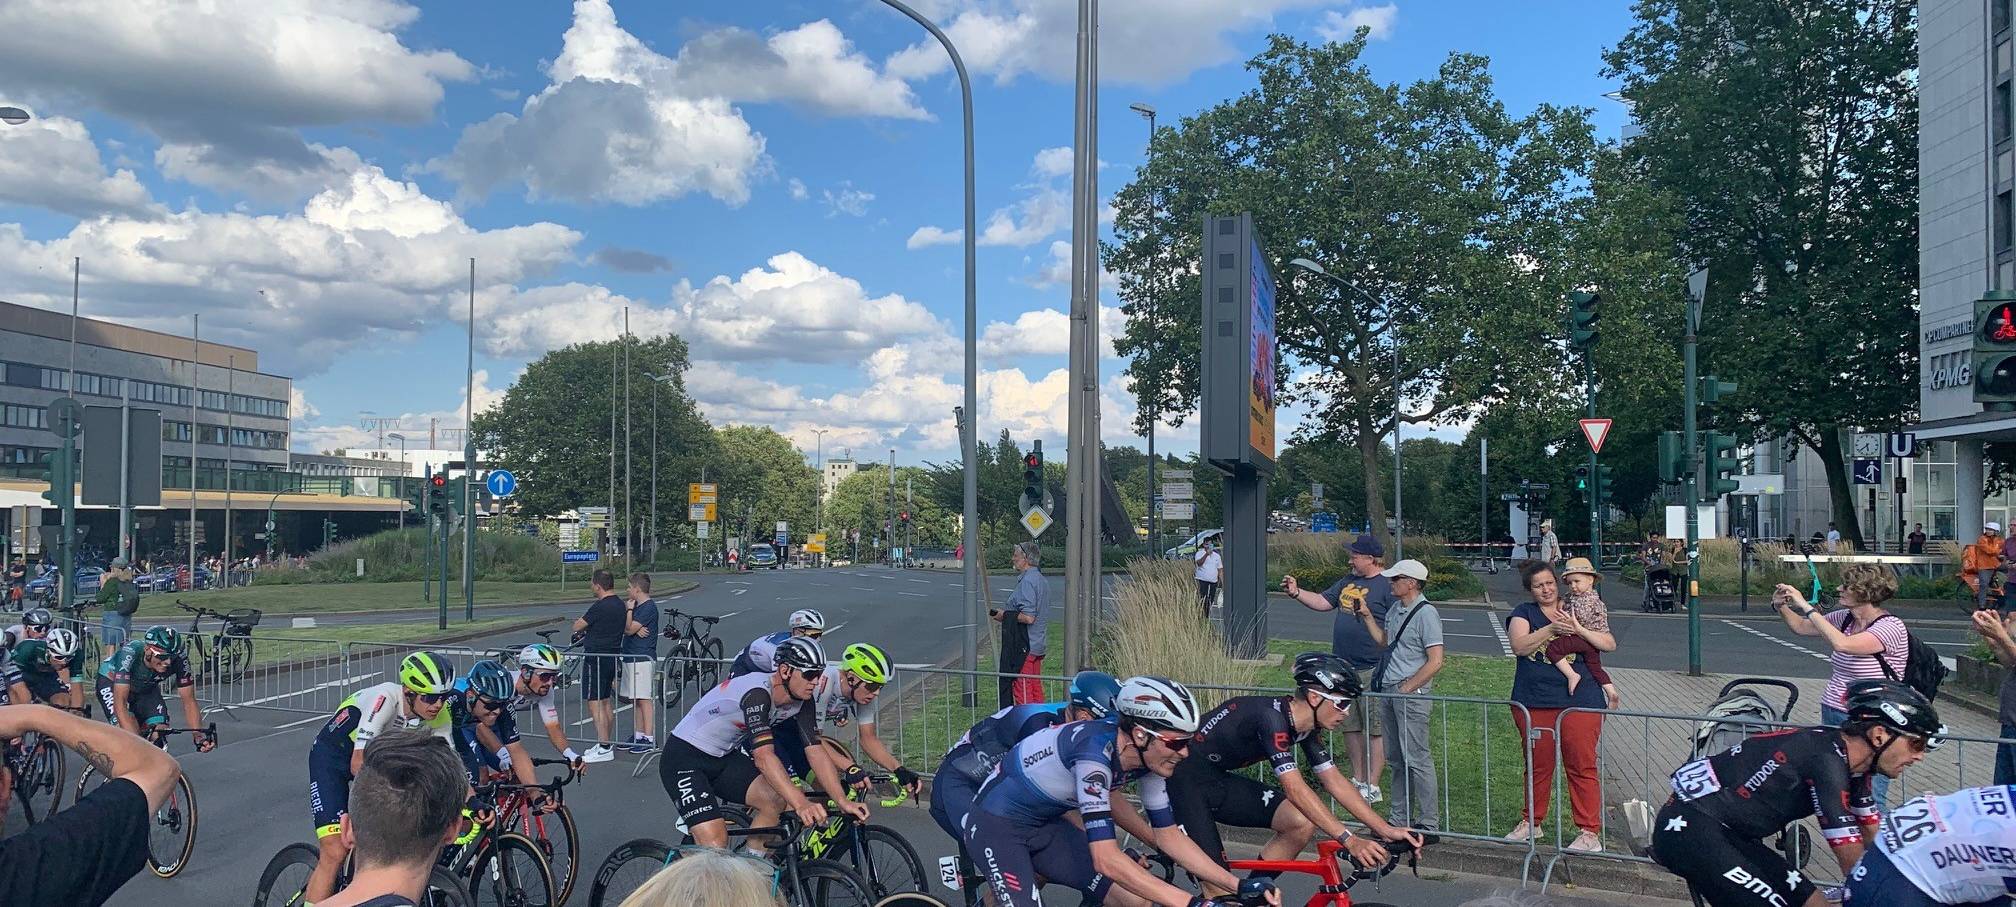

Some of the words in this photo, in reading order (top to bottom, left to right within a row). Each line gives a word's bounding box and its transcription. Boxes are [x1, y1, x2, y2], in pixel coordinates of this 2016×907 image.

[1930, 363, 1970, 390] KPMG
[1891, 434, 1912, 457] U
[564, 553, 597, 561] Europaplatz
[1123, 706, 1168, 717] SPECIALIZED
[1201, 708, 1230, 735] TUDOR
[1024, 746, 1053, 768] SOUDAL
[1679, 763, 1713, 794] 145
[1745, 760, 1779, 791] TUDOR
[678, 777, 696, 806] UAE
[1931, 844, 2016, 869] DAUNER
[940, 863, 956, 883] 124
[1723, 866, 1788, 907] BMC
